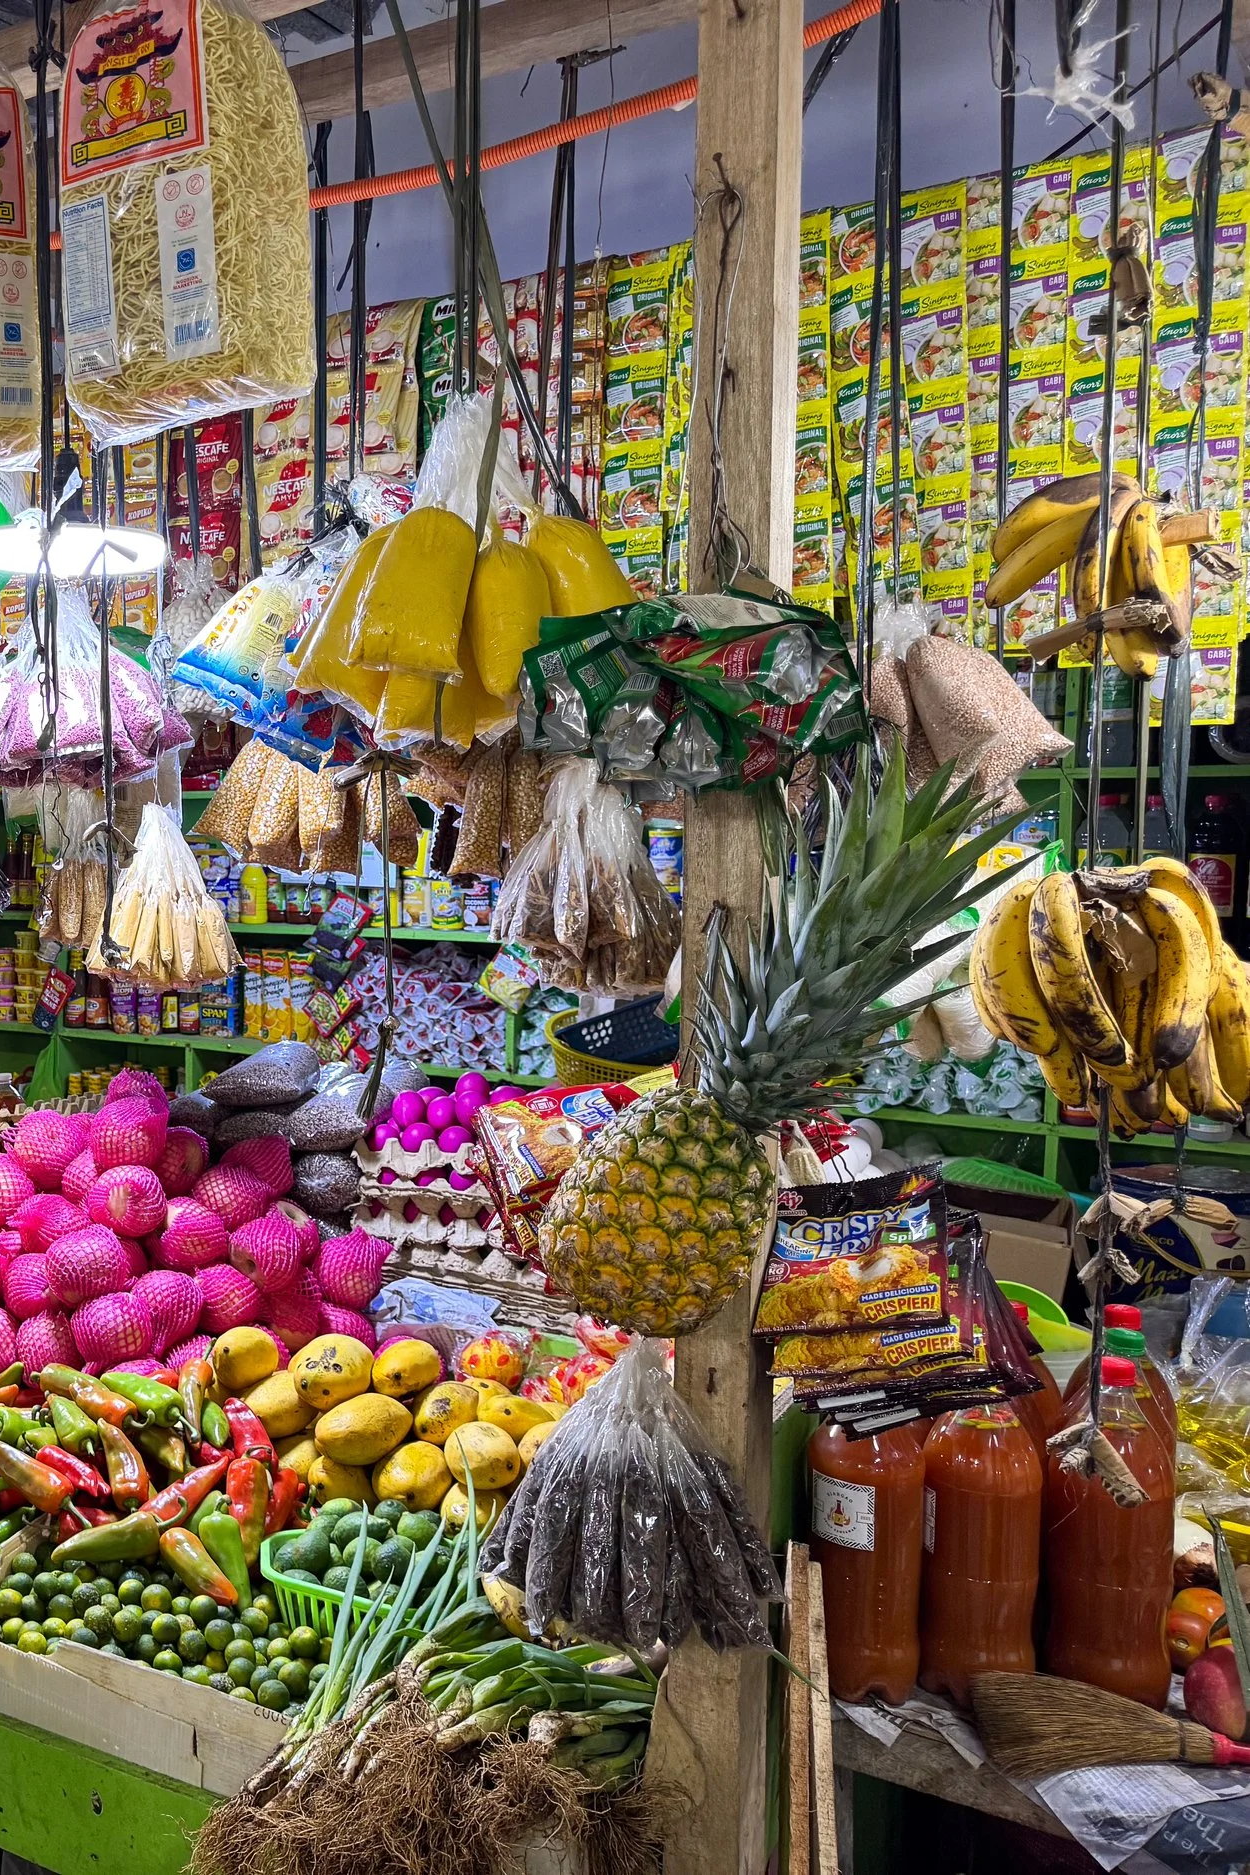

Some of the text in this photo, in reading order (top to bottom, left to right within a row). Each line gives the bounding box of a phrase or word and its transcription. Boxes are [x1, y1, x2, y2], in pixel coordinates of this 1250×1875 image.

[1078, 172, 1110, 188] Knorr
[63, 200, 104, 217] Nutrition Facts
[918, 194, 959, 213] Sinigang
[940, 212, 958, 223] GABI
[1162, 218, 1193, 234] Knorr
[1222, 228, 1243, 238] GABI
[967, 241, 998, 256] inigang
[979, 258, 997, 269] GABI
[1027, 257, 1067, 274] Sinigang
[633, 275, 666, 289] Sinigang
[1048, 275, 1065, 286] GABI
[1074, 277, 1106, 291] Knorr
[637, 291, 664, 302] ORIGINAL
[830, 290, 852, 307] Knorr
[921, 290, 958, 309] Sinigang
[942, 309, 959, 320] GABI
[1159, 323, 1191, 337] Knorr
[798, 334, 823, 348] RIGINAL
[967, 339, 996, 353] inigang
[1218, 335, 1239, 346] GABI
[979, 357, 996, 367] GABI
[1023, 357, 1064, 373] Sinigang
[631, 363, 663, 377] Sinigang
[635, 380, 662, 390] ORIGINAL
[1044, 376, 1062, 387] GABI
[1071, 378, 1103, 393] Knorr
[837, 381, 863, 398] Knorr
[924, 390, 961, 406] Sinigang
[943, 406, 961, 418] GABI
[1155, 430, 1189, 443] Knorr
[1215, 440, 1236, 450] GABI
[196, 455, 220, 465] RIGINAL
[606, 452, 660, 469] Knorr Sinigang
[633, 468, 660, 478] ORIGINAL
[127, 507, 153, 521] KOPIKO
[947, 503, 963, 514] GABI
[928, 580, 966, 595] Sinigang
[947, 598, 964, 609] GABI
[1207, 650, 1228, 660] GABI
[202, 1007, 228, 1019] SPAM
[790, 1204, 908, 1245] CRISPY
[817, 1237, 874, 1259] FRY
[861, 1284, 936, 1302] MADE DELICIOUSLY
[864, 1298, 936, 1321] CRISPIER!
[882, 1325, 956, 1346] MADE DELICIOUSLY
[885, 1337, 955, 1364] CRISPIER!
[1182, 1805, 1227, 1853] The
